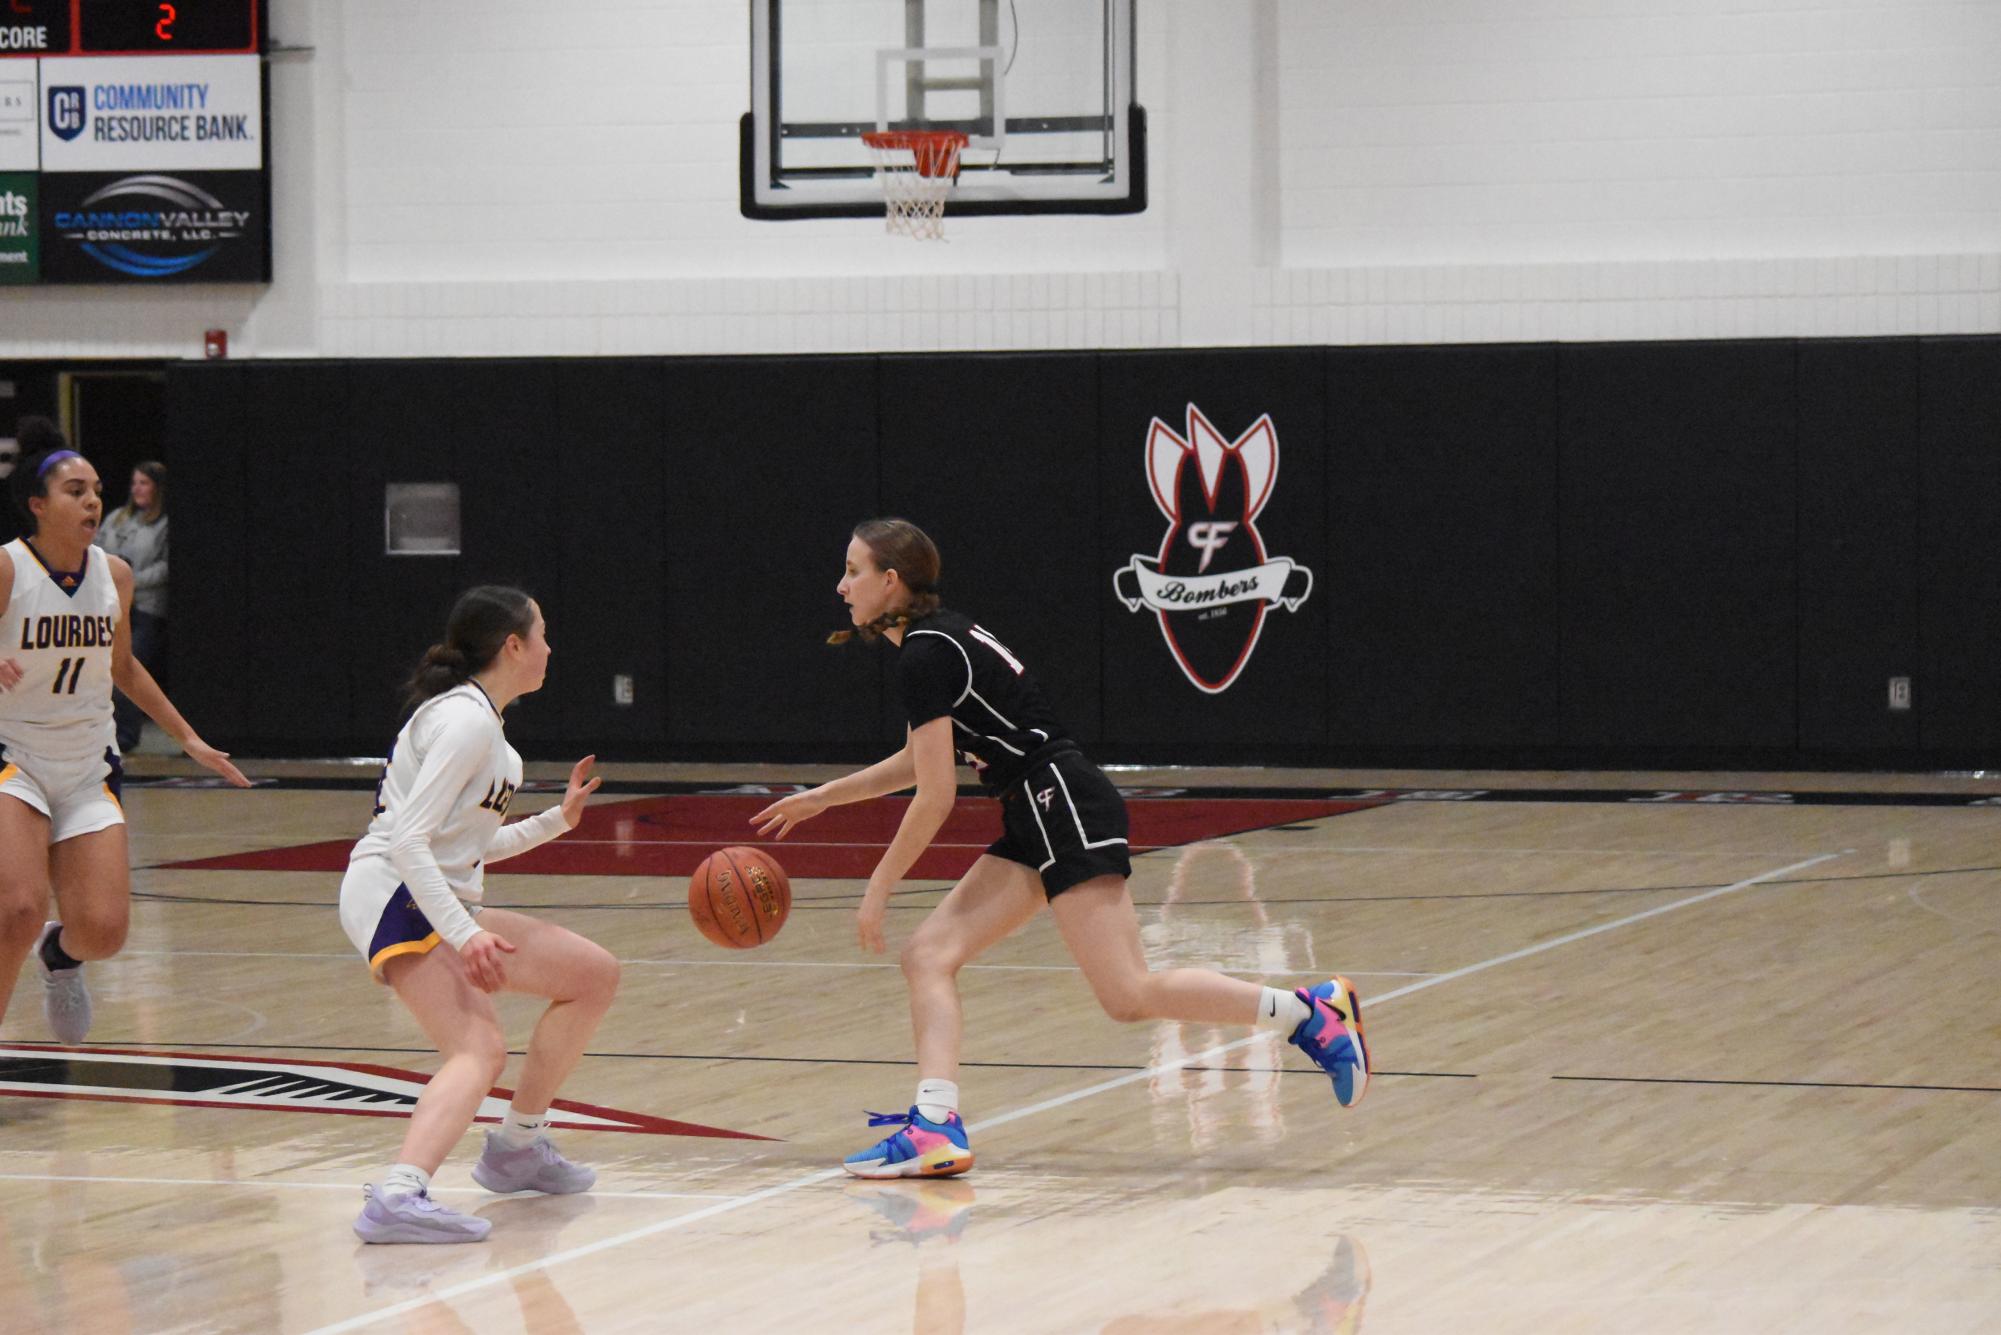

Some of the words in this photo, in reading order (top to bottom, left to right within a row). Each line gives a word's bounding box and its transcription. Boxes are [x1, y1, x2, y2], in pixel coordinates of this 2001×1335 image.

[155, 3, 176, 39] 2
[94, 84, 208, 110] COMMUNITY
[94, 115, 190, 142] RESOURCE
[1156, 576, 1259, 603] Bombers
[21, 614, 114, 650] LOURDES
[52, 657, 85, 694] 11
